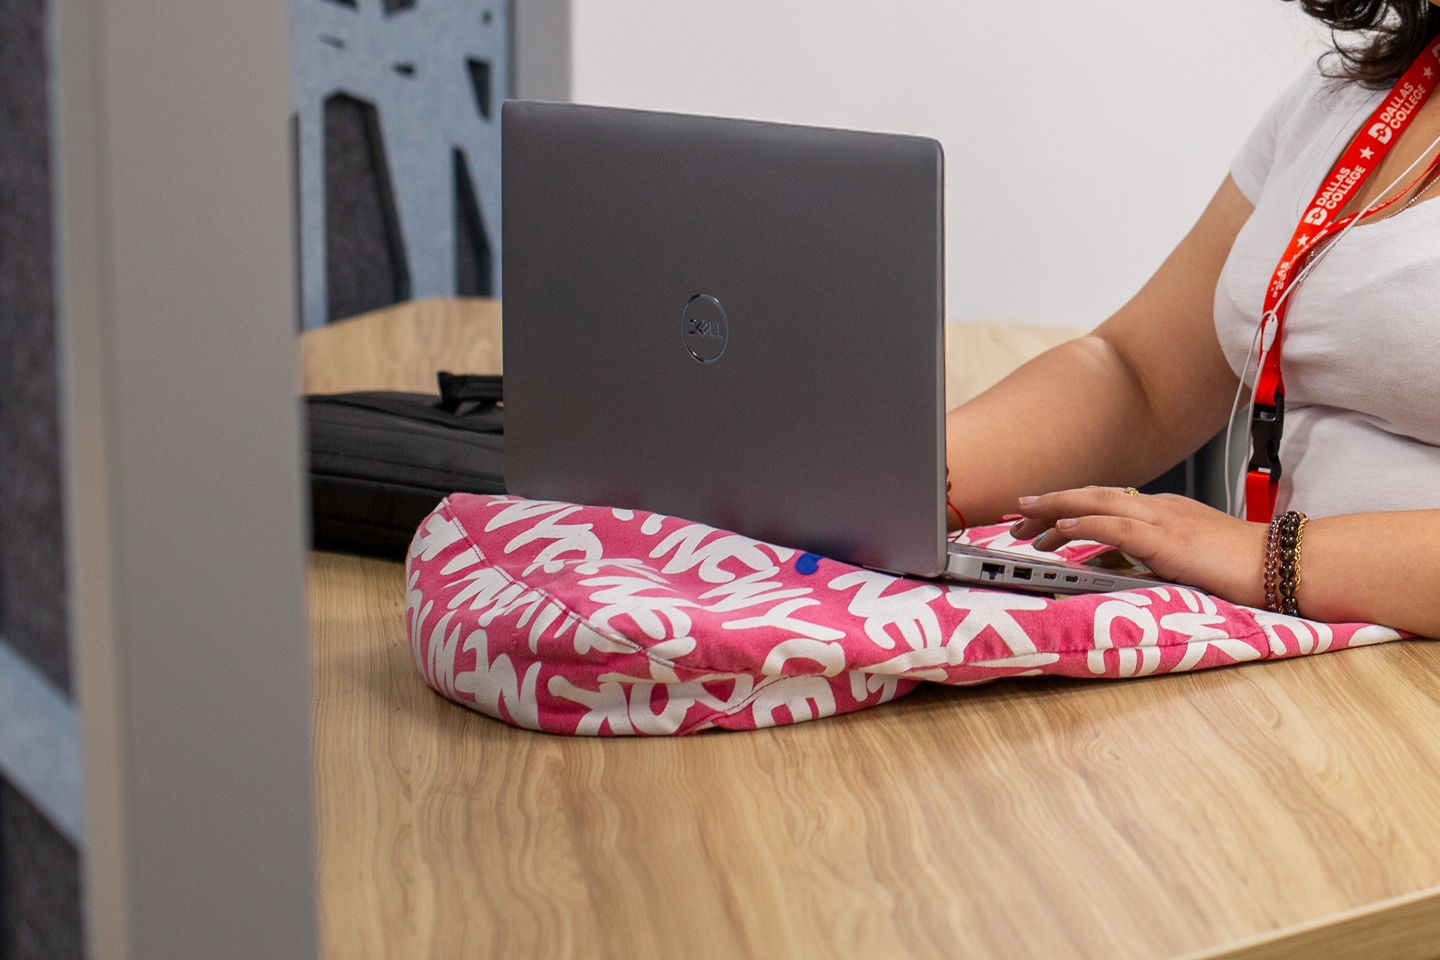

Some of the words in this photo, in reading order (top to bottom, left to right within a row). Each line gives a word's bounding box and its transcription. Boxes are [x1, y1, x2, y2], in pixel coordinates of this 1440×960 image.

[1379, 82, 1414, 123] DALLAS
[1390, 84, 1426, 129] COLLEGE
[1315, 167, 1351, 207] DALLAS
[1325, 165, 1366, 210] COLLEGE
[688, 319, 723, 339] DELL
